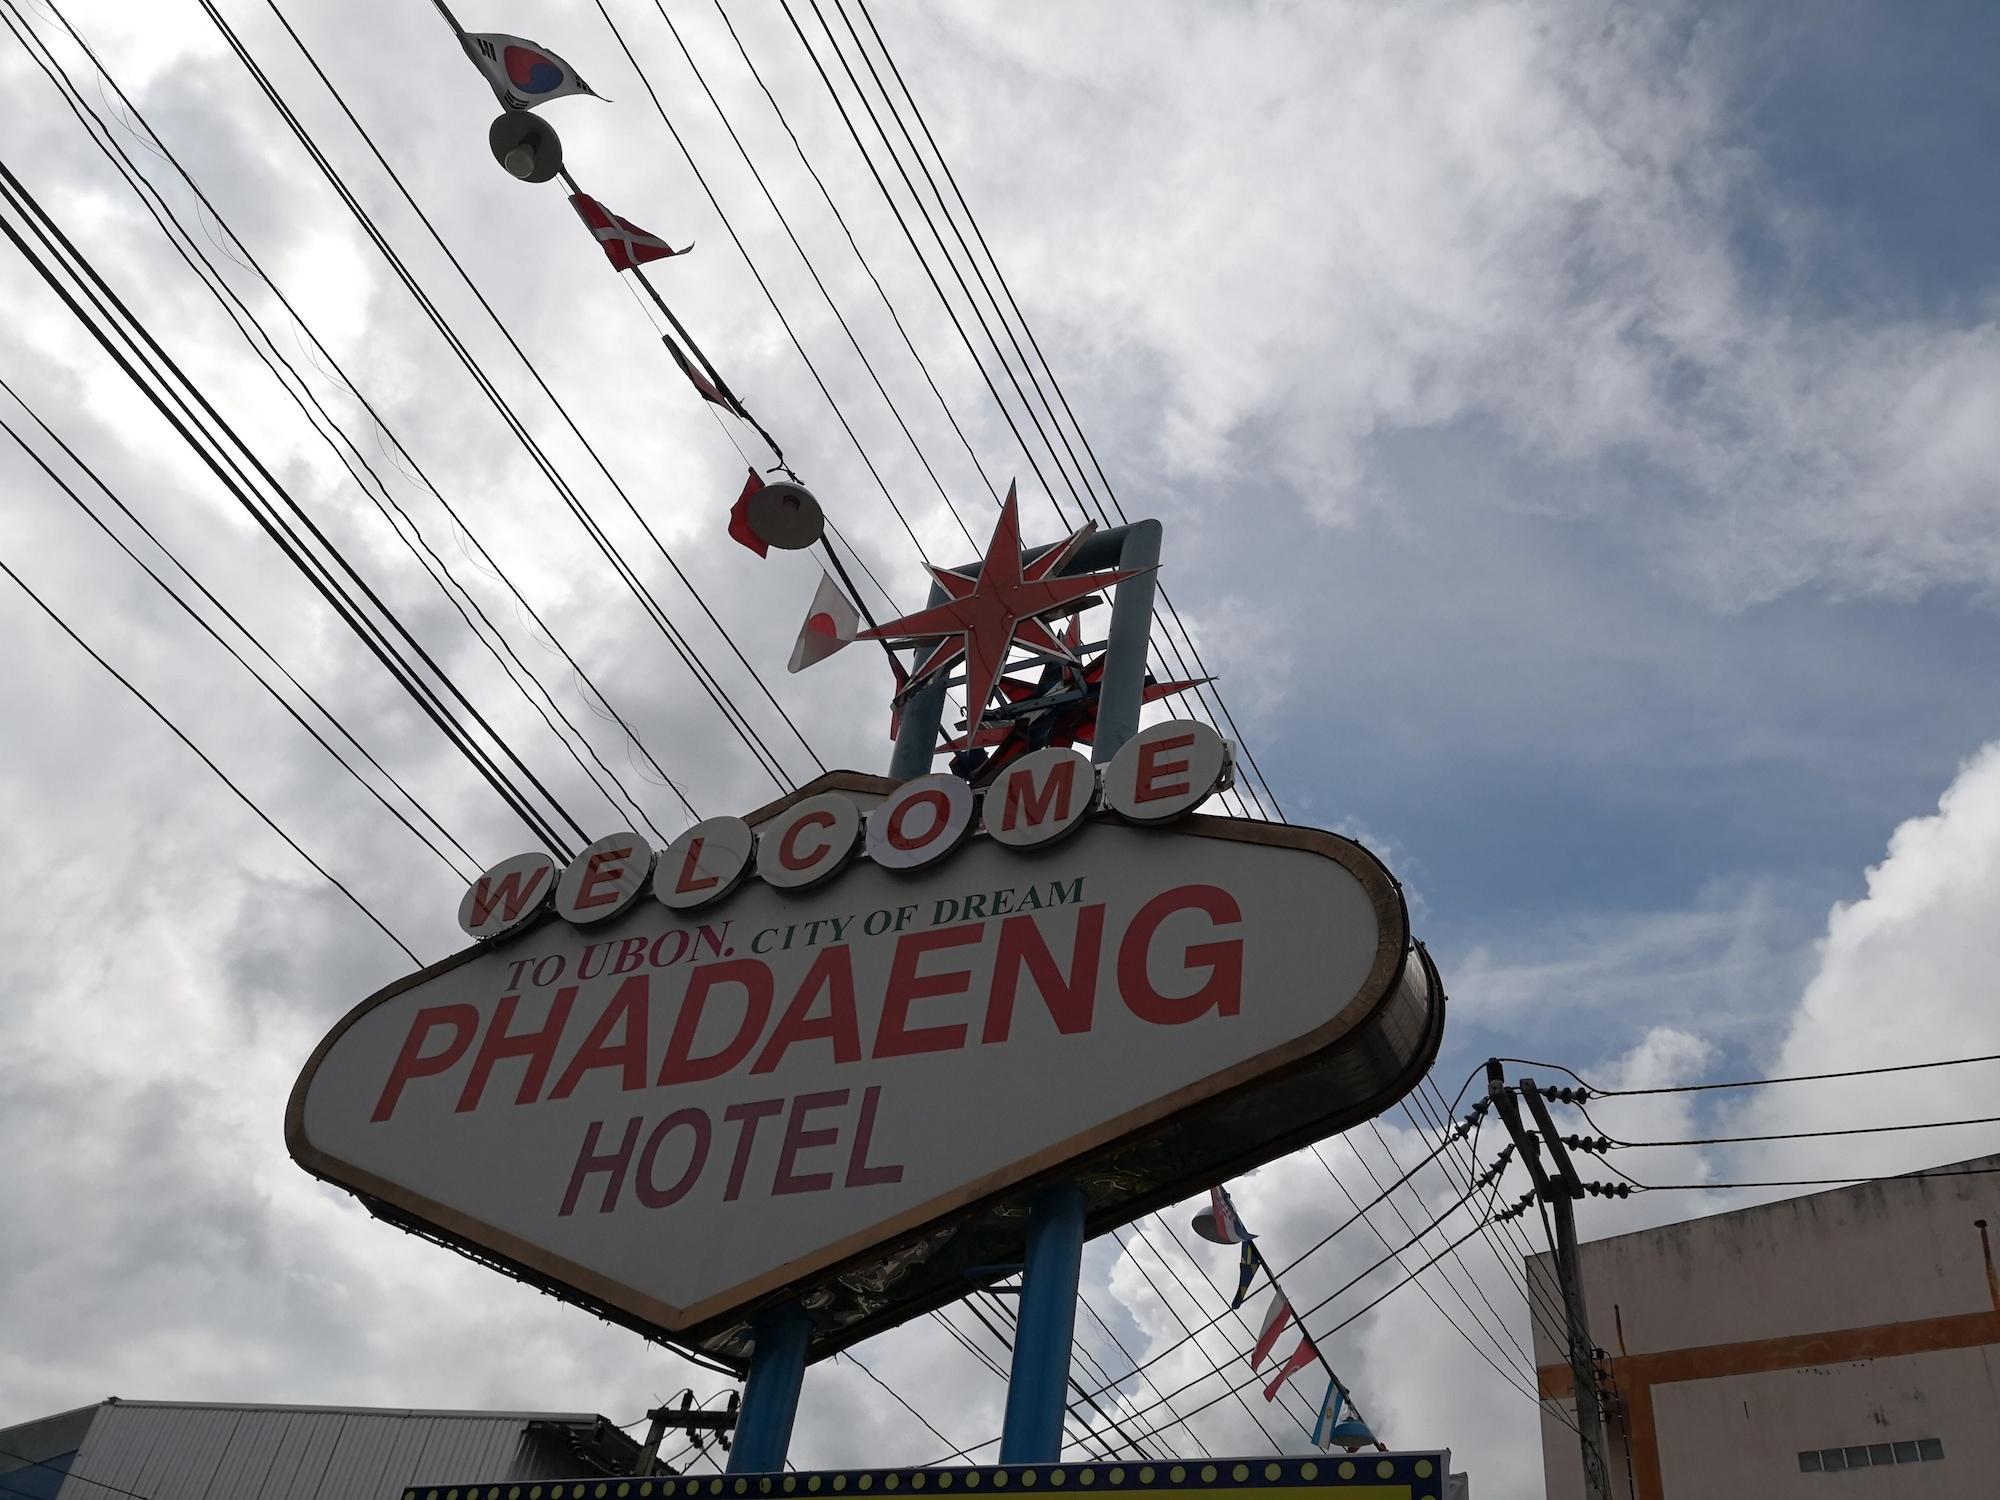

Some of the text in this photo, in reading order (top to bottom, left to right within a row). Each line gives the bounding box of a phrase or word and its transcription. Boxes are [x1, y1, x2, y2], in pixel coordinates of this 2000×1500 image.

[468, 733, 1196, 927] WELCOME
[371, 884, 1244, 1122] PHADAENG
[504, 877, 1086, 992] TO UBON. CITY OF DREAM
[558, 1085, 904, 1216] HOTEL
